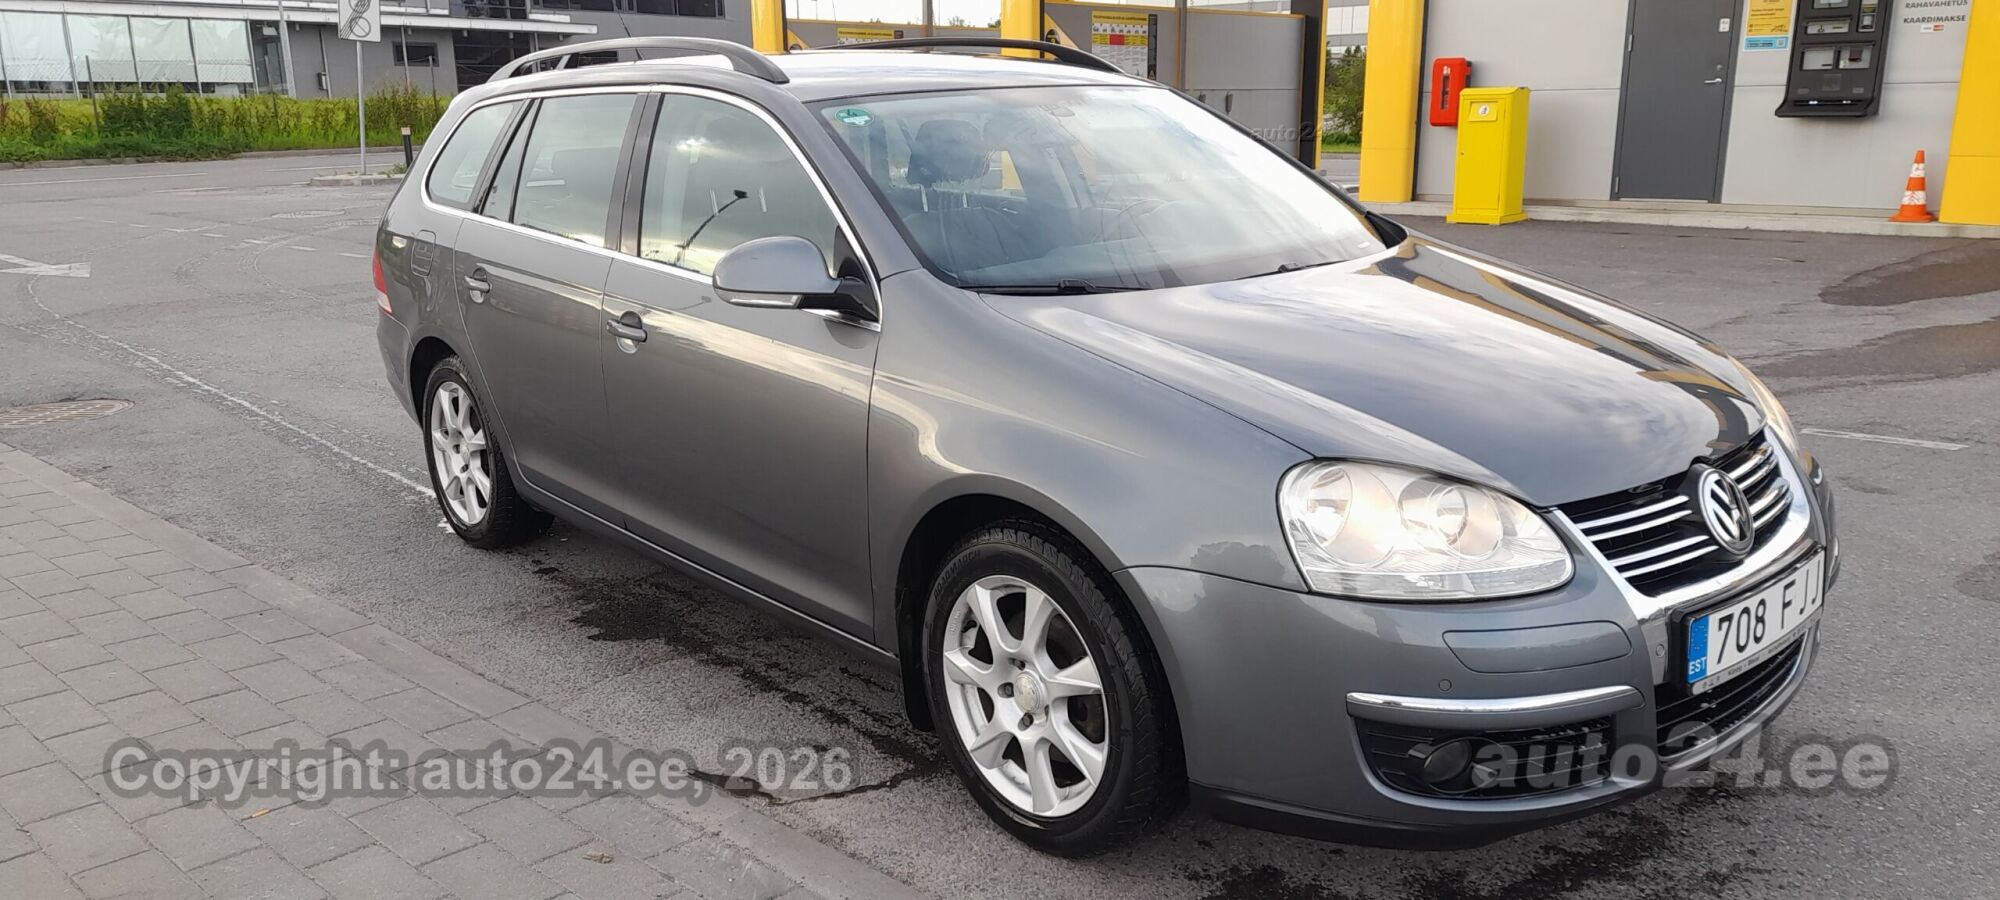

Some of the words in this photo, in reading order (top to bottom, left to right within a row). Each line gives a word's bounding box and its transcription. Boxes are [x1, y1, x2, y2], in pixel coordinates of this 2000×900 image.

[1905, 0, 1968, 8] RAHAVAHETUS
[1903, 15, 1966, 24] KAARDIMAKSE
[1717, 598, 1767, 665] 708
[1781, 559, 1821, 630] FJJ
[1689, 656, 1707, 675] EST
